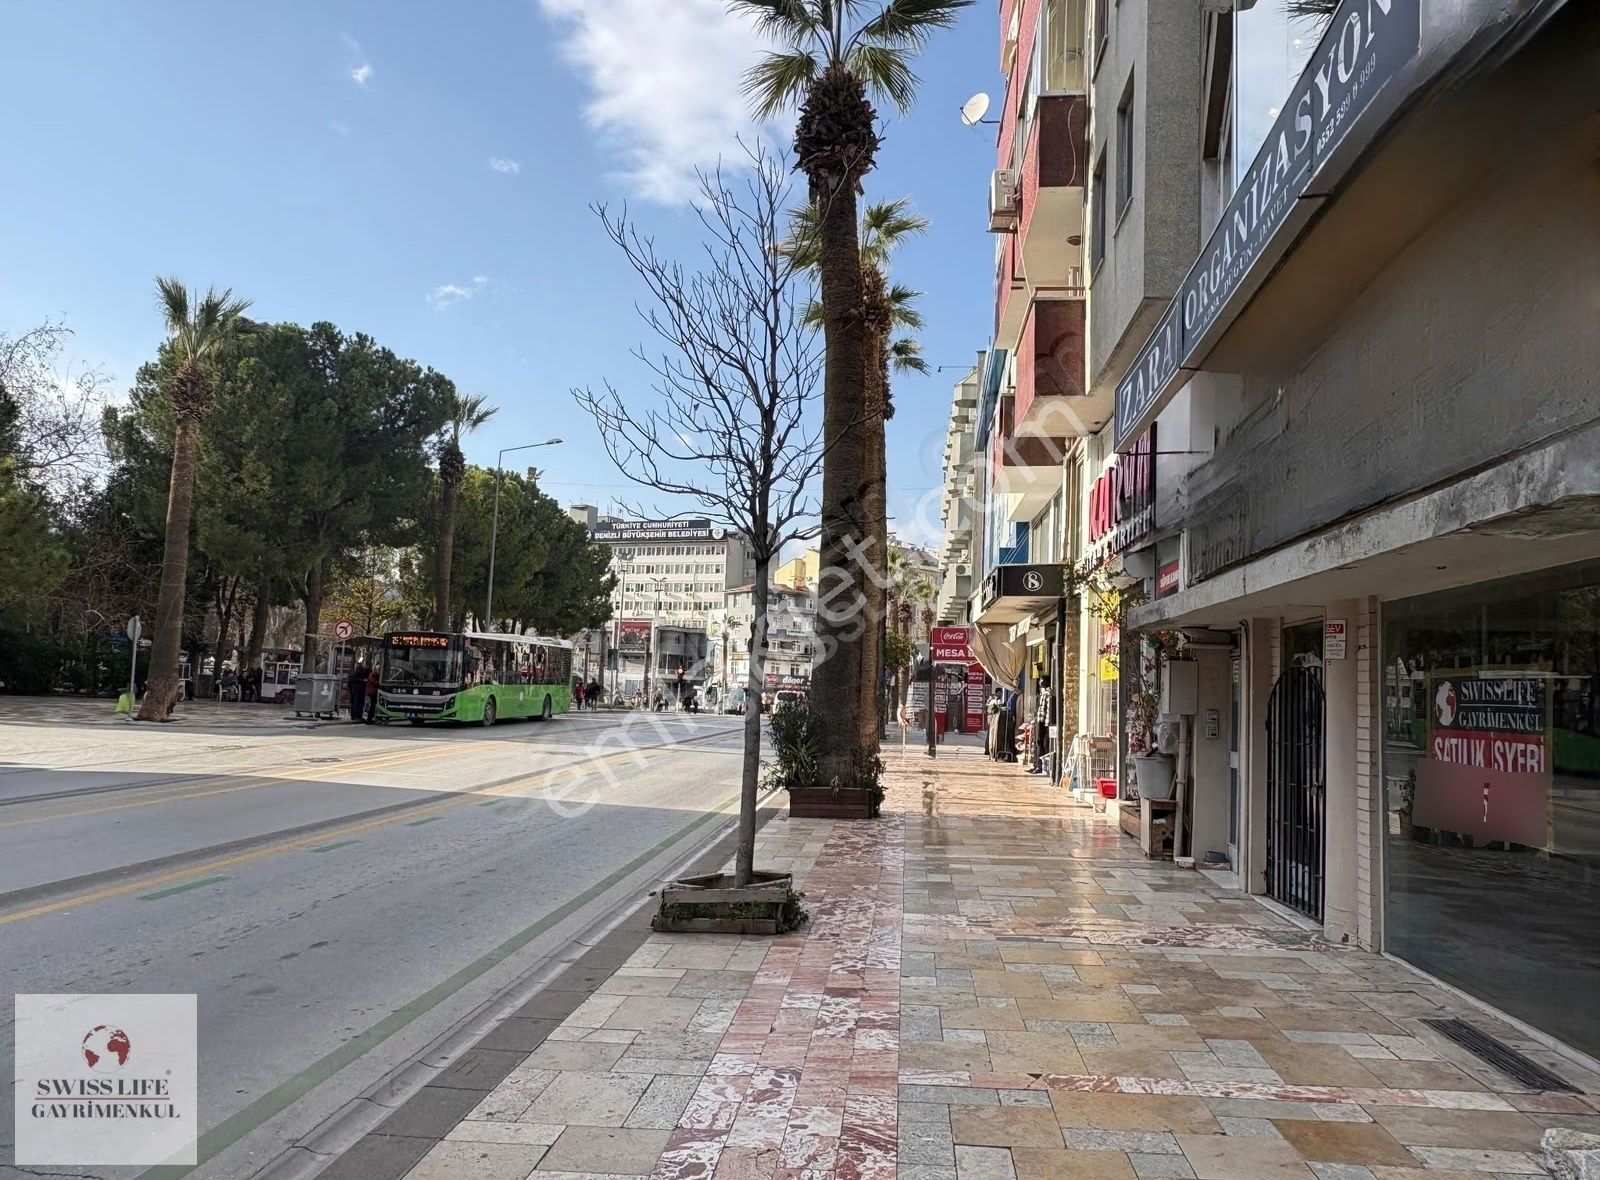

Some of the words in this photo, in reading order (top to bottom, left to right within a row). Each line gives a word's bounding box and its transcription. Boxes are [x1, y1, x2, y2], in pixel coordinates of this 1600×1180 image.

[1316, 117, 1335, 155] 0552
[1359, 52, 1376, 89] 999
[1122, 325, 1174, 433] ZARA
[594, 531, 621, 539] DENİZLİ
[622, 529, 666, 539] BÜYÜKŞEHİR
[667, 529, 709, 538] BELEDİYESİ
[936, 649, 966, 658] MESA
[782, 675, 805, 684] döner
[1458, 708, 1544, 731] GAYRİMENKUL
